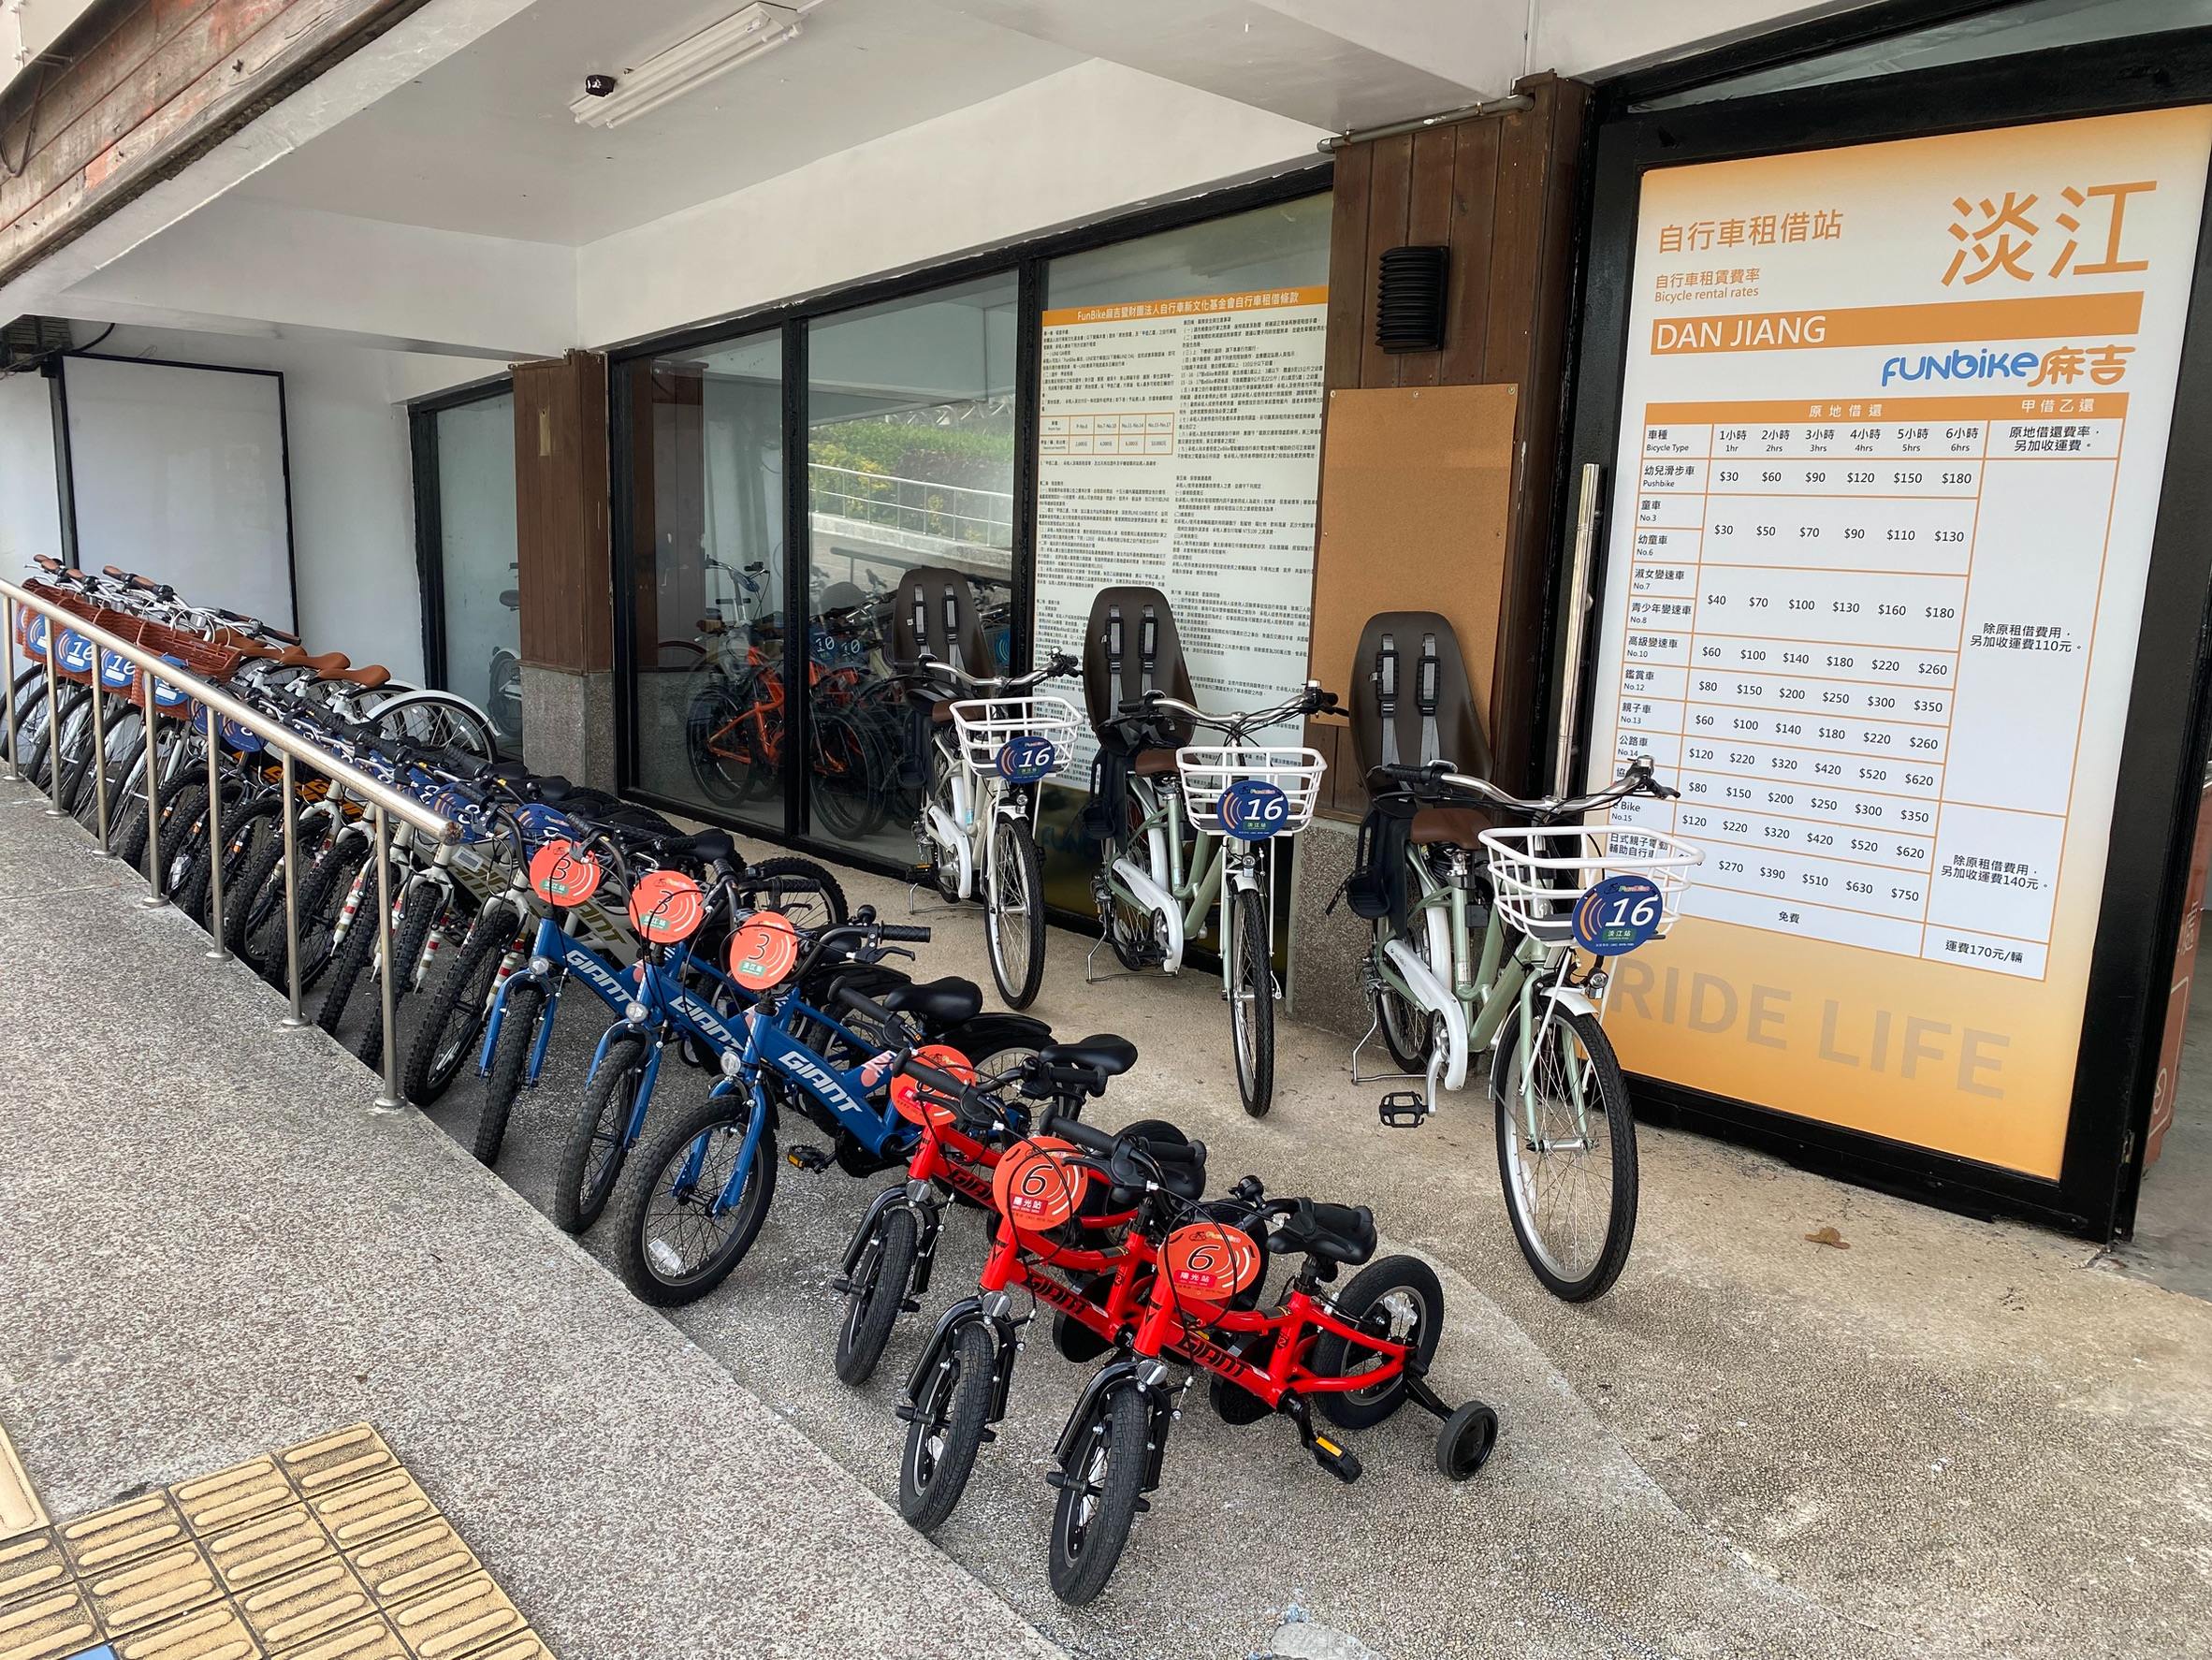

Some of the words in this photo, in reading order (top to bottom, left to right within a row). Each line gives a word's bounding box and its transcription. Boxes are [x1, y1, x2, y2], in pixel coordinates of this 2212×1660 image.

[1658, 209, 1843, 254] 自行車租借站
[1941, 181, 2157, 286] 淡江
[1655, 268, 1760, 289] 自行車租賃費率
[1655, 288, 1692, 302] Bicycle
[1695, 287, 1726, 299] rental
[1730, 285, 1759, 298] rates
[1656, 320, 1723, 349] DAN
[1730, 316, 1826, 346] JIANG
[1809, 403, 1883, 417] 原地借還
[2022, 398, 2094, 414] 甲借乙還
[1649, 430, 1666, 439] 車種
[1721, 430, 1746, 440] 1小時
[1762, 430, 1789, 440] 2小時
[1806, 430, 1834, 440] 3小時
[1850, 429, 1881, 439] 4小時
[1898, 429, 1928, 439] 5小時
[1946, 428, 1978, 439] 6小時
[1645, 466, 1694, 475] 幼兒滑步車
[1720, 472, 1739, 482] $30
[1762, 472, 1781, 482] $60
[1806, 473, 1826, 483] $90
[1848, 473, 1874, 483] $120
[1894, 473, 1922, 484] $150
[1943, 473, 1972, 484] $180
[1641, 501, 1661, 510] 童車
[1638, 535, 1666, 545] 幼童車
[1715, 525, 1733, 534] $30
[1757, 526, 1775, 535] $50
[1800, 527, 1819, 537] $70
[1844, 529, 1864, 539] $90
[1887, 530, 1914, 540] $110
[1935, 531, 1964, 542] $130
[1635, 569, 1684, 579] 淑女變速車
[1631, 603, 1691, 616] 青少年變速車
[1709, 595, 1725, 604] $40
[1750, 597, 1768, 607] $70
[1789, 599, 1814, 610] $100
[1833, 602, 1859, 612] $130
[1879, 604, 1906, 615] $160
[1926, 607, 1954, 618] $180
[1629, 636, 1677, 648] 高級變速車
[1703, 647, 1721, 657] $60
[1740, 649, 1766, 660] $100
[1783, 653, 1809, 663] $140
[1826, 657, 1853, 667] $180
[1872, 660, 1899, 671] $220
[1918, 663, 1947, 675] $260
[1626, 669, 1653, 680] 鑑賞車
[1699, 681, 1717, 692] $80
[1738, 684, 1762, 695] $150
[1780, 688, 1805, 699] $200
[1823, 692, 1849, 704] $250
[1868, 696, 1895, 707] $300
[1914, 700, 1943, 712] $350
[1623, 703, 1651, 713] 親子車
[1622, 716, 1640, 724] No.13
[1619, 735, 1647, 748] 公路車
[1695, 715, 1713, 725] $60
[1734, 719, 1758, 730] $100
[1776, 723, 1801, 735] $140
[1819, 728, 1845, 739] $180
[1864, 733, 1890, 744] $220
[1910, 737, 1938, 749] $260
[1019, 747, 1052, 767] 16
[1617, 748, 1638, 757] No.14
[1690, 749, 1713, 760] $120
[1730, 753, 1754, 764] $220
[1772, 758, 1797, 769] $320
[1815, 764, 1841, 775] $420
[1859, 768, 1886, 780] $520
[1905, 774, 1933, 786] $620
[1244, 795, 1284, 821] 16
[1621, 801, 1641, 812] Bike
[1689, 782, 1707, 793] $80
[1726, 787, 1751, 798] $150
[1768, 793, 1793, 804] $200
[1812, 798, 1837, 809] $250
[1855, 804, 1882, 816] $300
[1901, 810, 1928, 822] $350
[1611, 812, 1633, 823] No.15
[1683, 815, 1706, 826] $120
[1724, 821, 1747, 832] $220
[1765, 827, 1789, 838] $320
[1808, 833, 1833, 845] $420
[1851, 839, 1878, 852] $520
[1897, 846, 1924, 858] $620
[548, 856, 573, 881] 3
[1719, 861, 1743, 872] $270
[1760, 867, 1785, 880] $390
[1803, 874, 1828, 886] $510
[1846, 881, 1872, 894] $630
[1892, 888, 1918, 901] $750
[648, 890, 675, 916] 3
[1605, 895, 1659, 926] 16
[1779, 911, 1799, 924] 免費
[748, 932, 771, 961] 3
[563, 950, 634, 1003] GIANT
[669, 996, 745, 1052] GIANT
[1609, 957, 1792, 1050] RIDE
[1818, 999, 2010, 1099] LIFE
[779, 1051, 863, 1113] GIANT
[1021, 1163, 1054, 1197] 6
[1186, 1244, 1221, 1272] 6
